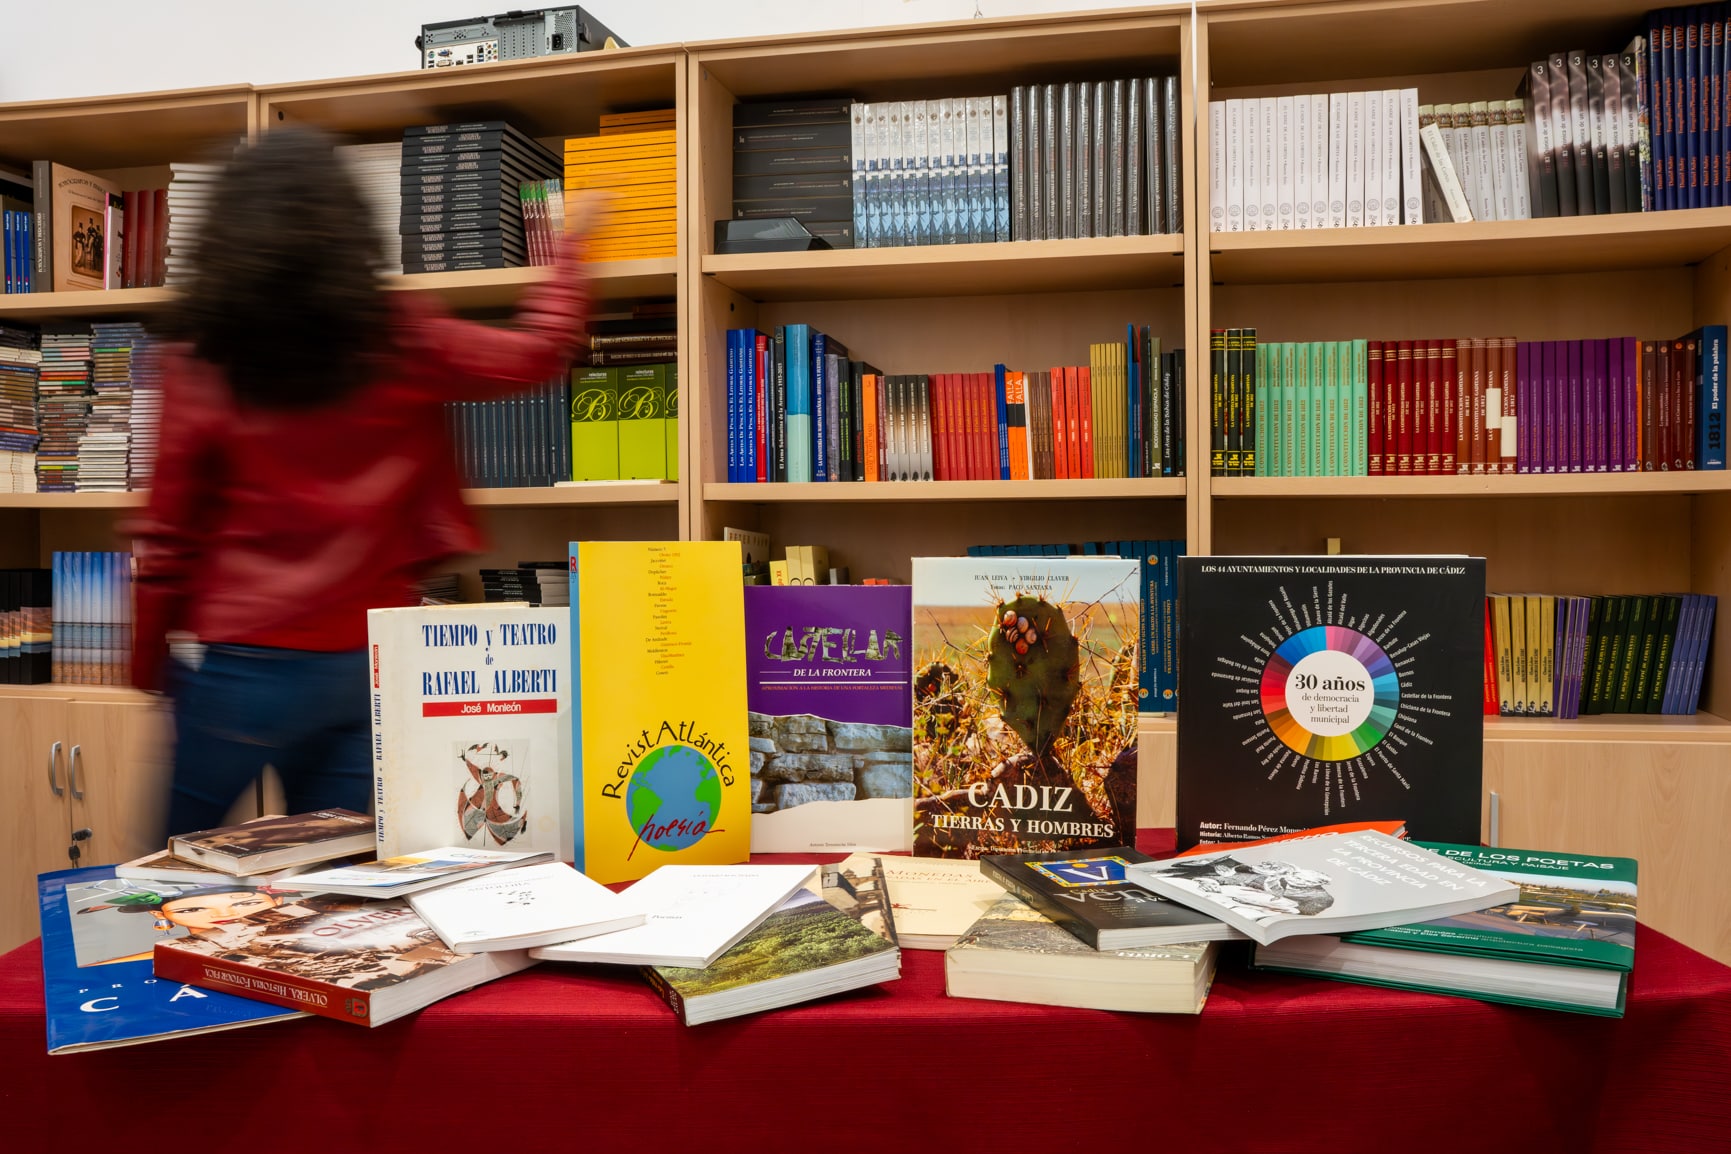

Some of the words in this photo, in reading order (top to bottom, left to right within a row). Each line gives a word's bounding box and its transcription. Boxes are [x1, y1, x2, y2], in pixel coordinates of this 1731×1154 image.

[1556, 58, 1562, 68] 3
[1574, 56, 1581, 66] 3
[1592, 59, 1598, 69] 3
[1608, 58, 1615, 68] 3
[1624, 56, 1631, 66] 3
[1537, 65, 1544, 75] 3
[1712, 338, 1720, 362] palabra
[1712, 362, 1718, 370] la
[1712, 372, 1719, 382] de
[1712, 383, 1720, 400] poder
[1708, 412, 1721, 450] 1812
[570, 556, 578, 572] R
[1201, 565, 1216, 573] LOS
[1226, 565, 1294, 574] AYUNTAMIENTOS
[1301, 566, 1356, 574] LOCALIDADES
[1381, 566, 1426, 575] PROVINCIA
[1439, 565, 1466, 575] CÁDIZ
[422, 624, 478, 647] TIEMPO
[485, 630, 493, 652] y
[500, 623, 556, 646] TEATRO
[764, 626, 903, 664] CASTELLAR
[486, 654, 494, 666] de
[793, 668, 808, 677] DE
[808, 668, 820, 677] LA
[822, 668, 872, 677] FRONTERA
[422, 670, 480, 696] RAFAEL
[492, 668, 556, 694] ALBERTI
[1295, 673, 1318, 690] 30
[1322, 676, 1366, 691] años
[1302, 692, 1312, 701] de
[1313, 692, 1360, 703] democracia
[374, 693, 382, 726] ALBERTI
[461, 704, 482, 714] José
[1310, 706, 1316, 714] y
[1318, 704, 1348, 713] libertad
[1310, 715, 1350, 726] municipal
[968, 782, 1074, 812] CADIZ
[931, 814, 1006, 832] TIERRAS
[1010, 818, 1021, 834] Y
[1026, 820, 1114, 838] HOMBRES
[1200, 821, 1222, 830] Autor:
[1223, 822, 1258, 832] Fernando
[1258, 824, 1279, 833] Pérez
[1332, 848, 1351, 858] LA
[1352, 855, 1428, 890] PROVINCIA
[1344, 840, 1399, 866] TERCERA
[1398, 862, 1440, 882] EDAD
[1442, 879, 1465, 891] EN
[1360, 835, 1428, 862] RECURSOS
[1428, 858, 1464, 880] PARA
[1466, 876, 1488, 888] LA
[1478, 852, 1520, 862] LOS
[1526, 856, 1615, 870] POETAS
[1521, 862, 1570, 871] PAISAJE
[1326, 858, 1347, 868] DE
[1348, 865, 1392, 886] CÁDIZ
[312, 906, 414, 937] OLVER
[288, 988, 328, 1006] OLVERA.
